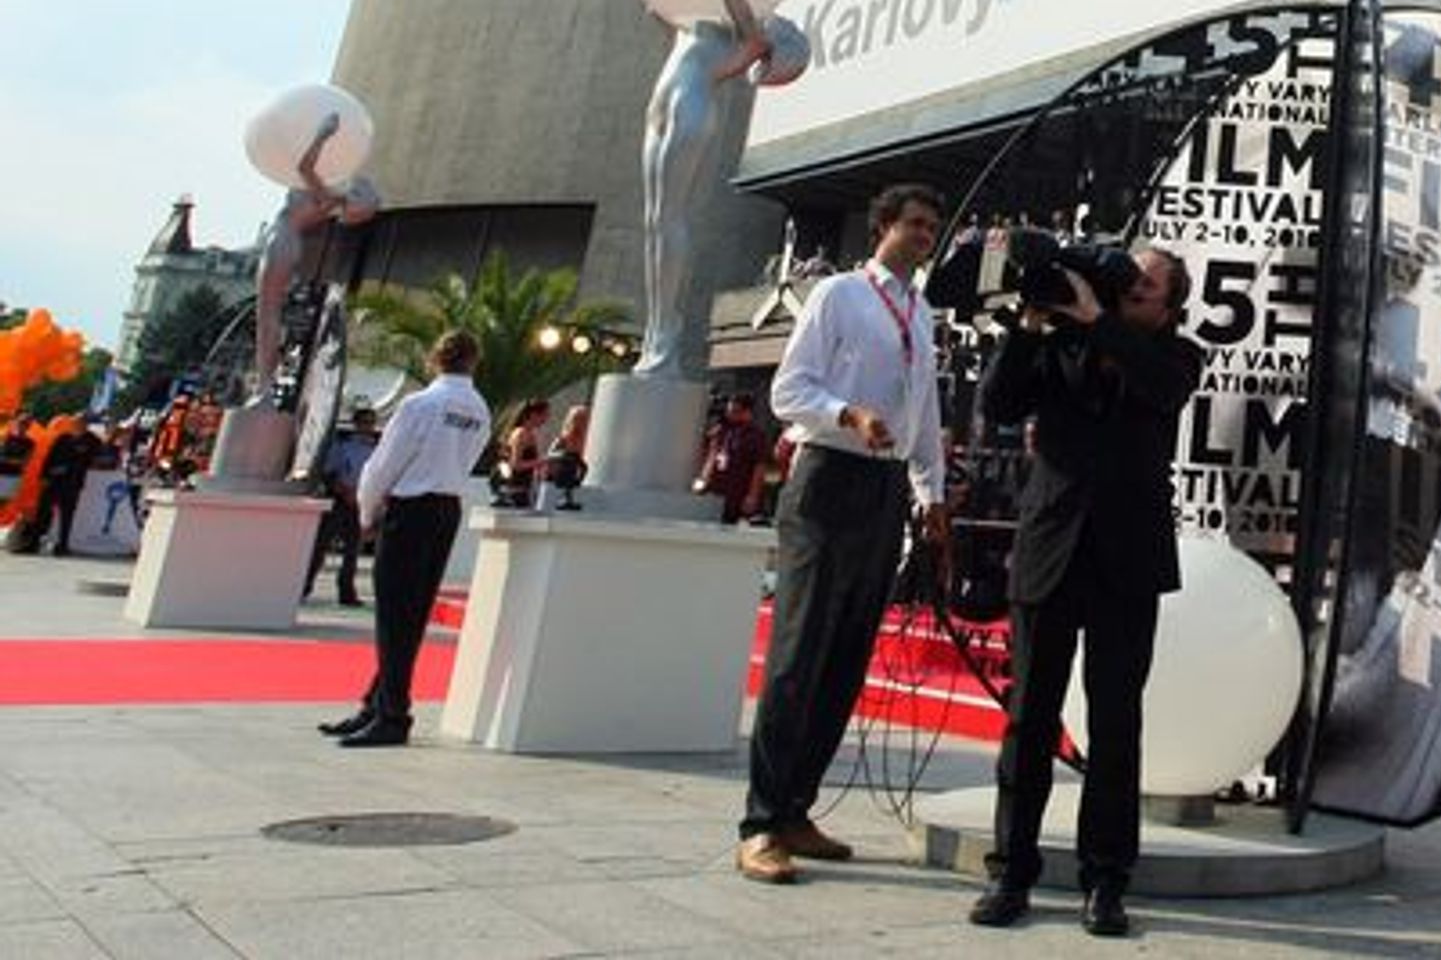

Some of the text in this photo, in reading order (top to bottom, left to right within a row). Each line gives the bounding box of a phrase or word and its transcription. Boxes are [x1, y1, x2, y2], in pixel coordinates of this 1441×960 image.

[1268, 82, 1330, 103] VARY
[1213, 102, 1328, 124] NATIONAL
[1186, 124, 1322, 191] ILM
[1156, 187, 1321, 225] ESTIVAL
[1143, 222, 1187, 240] ULY
[1244, 351, 1309, 373] VARY
[1202, 372, 1308, 397] ATIONAL
[1188, 395, 1302, 470] LM
[1172, 468, 1299, 508] TIVAL
